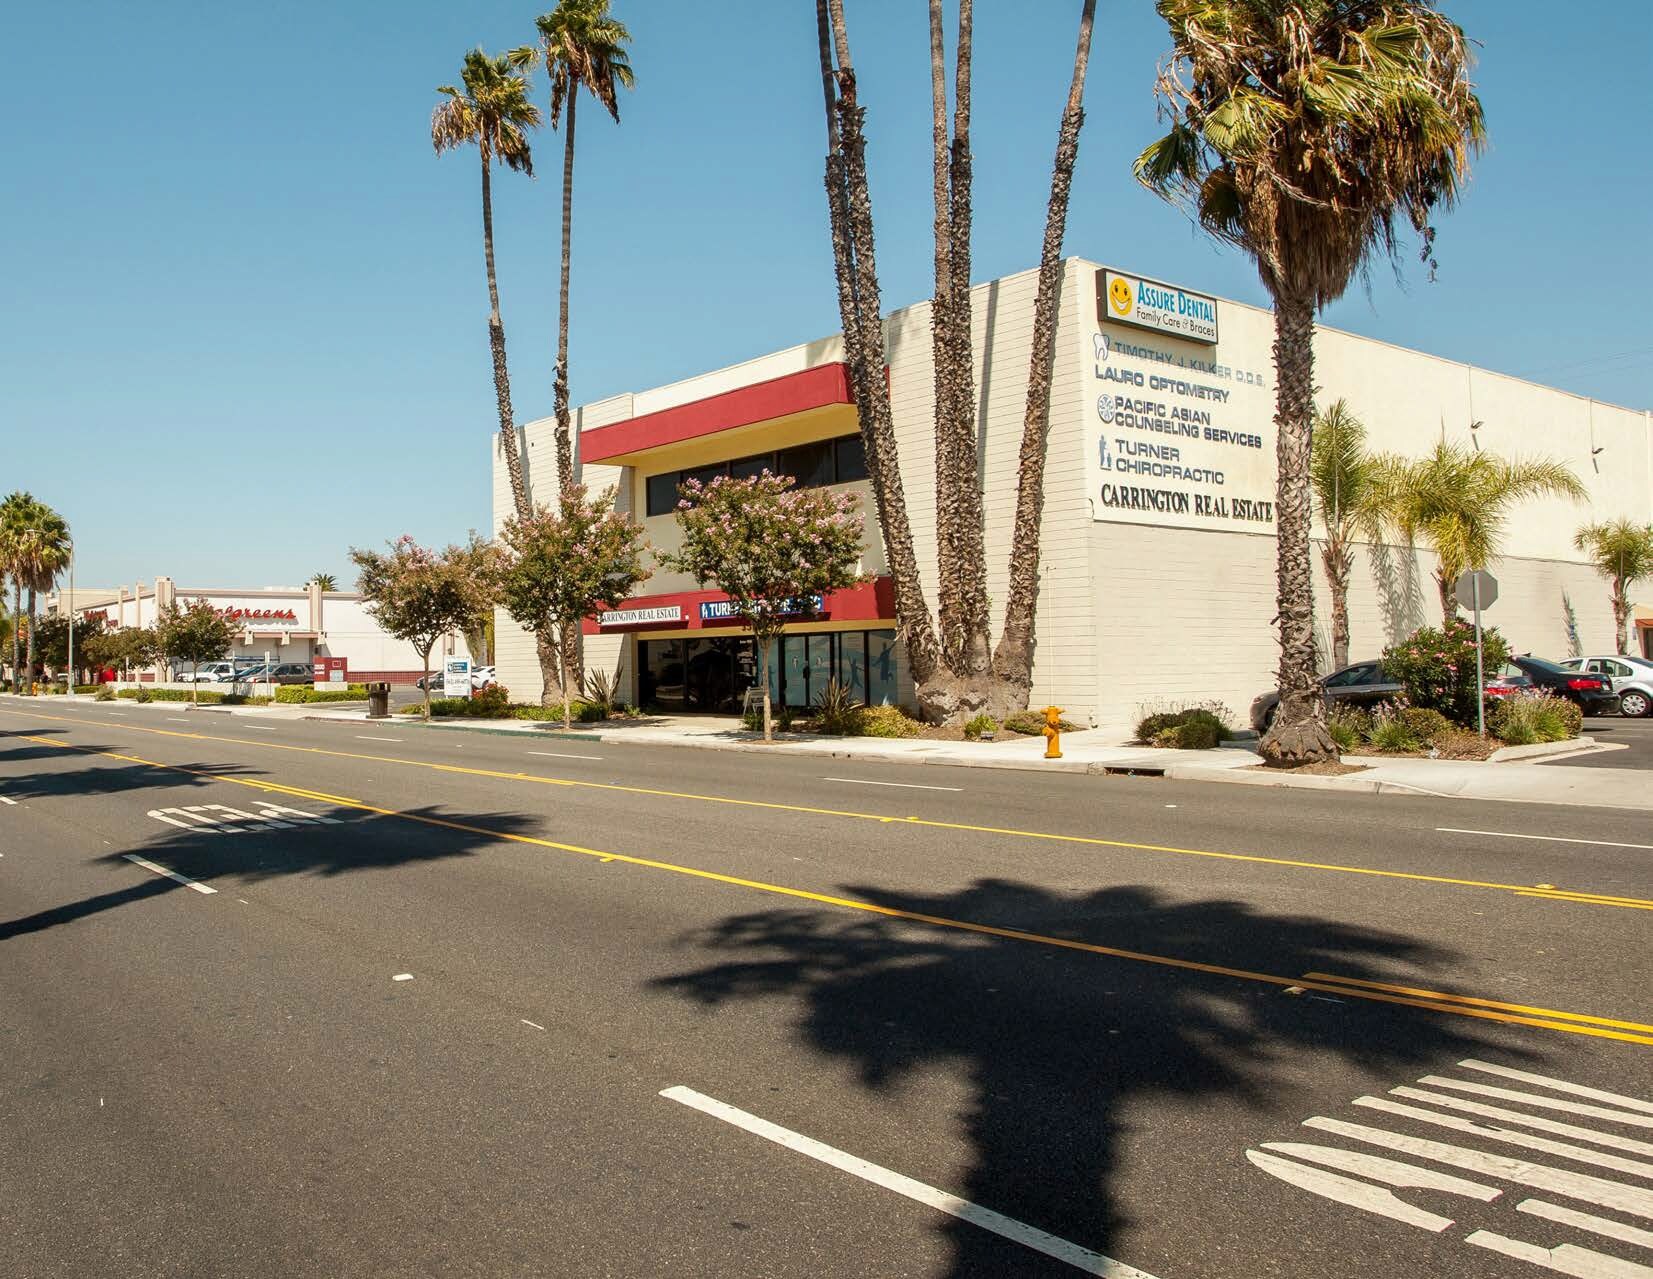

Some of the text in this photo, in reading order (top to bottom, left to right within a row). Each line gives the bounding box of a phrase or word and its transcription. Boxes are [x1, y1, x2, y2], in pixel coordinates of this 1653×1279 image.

[1138, 281, 1214, 322] ASSURE DENTAL
[1137, 308, 1161, 326] Family
[1163, 313, 1180, 328] Care
[1190, 320, 1214, 336] Braces
[1115, 342, 1172, 363] TIMOTHY
[1096, 365, 1230, 403] LAURO OPTOMETRY
[1115, 396, 1210, 425] PACIFIC ASIAN
[1115, 412, 1262, 448] COUNSELING SERVICES
[1115, 439, 1180, 462] TURNER
[1116, 458, 1224, 485] CHIROPRACTIC
[1101, 483, 1273, 522] CARRINGTON REAL ESTATE
[603, 608, 679, 622] ARRINGTON REAL ESTATE
